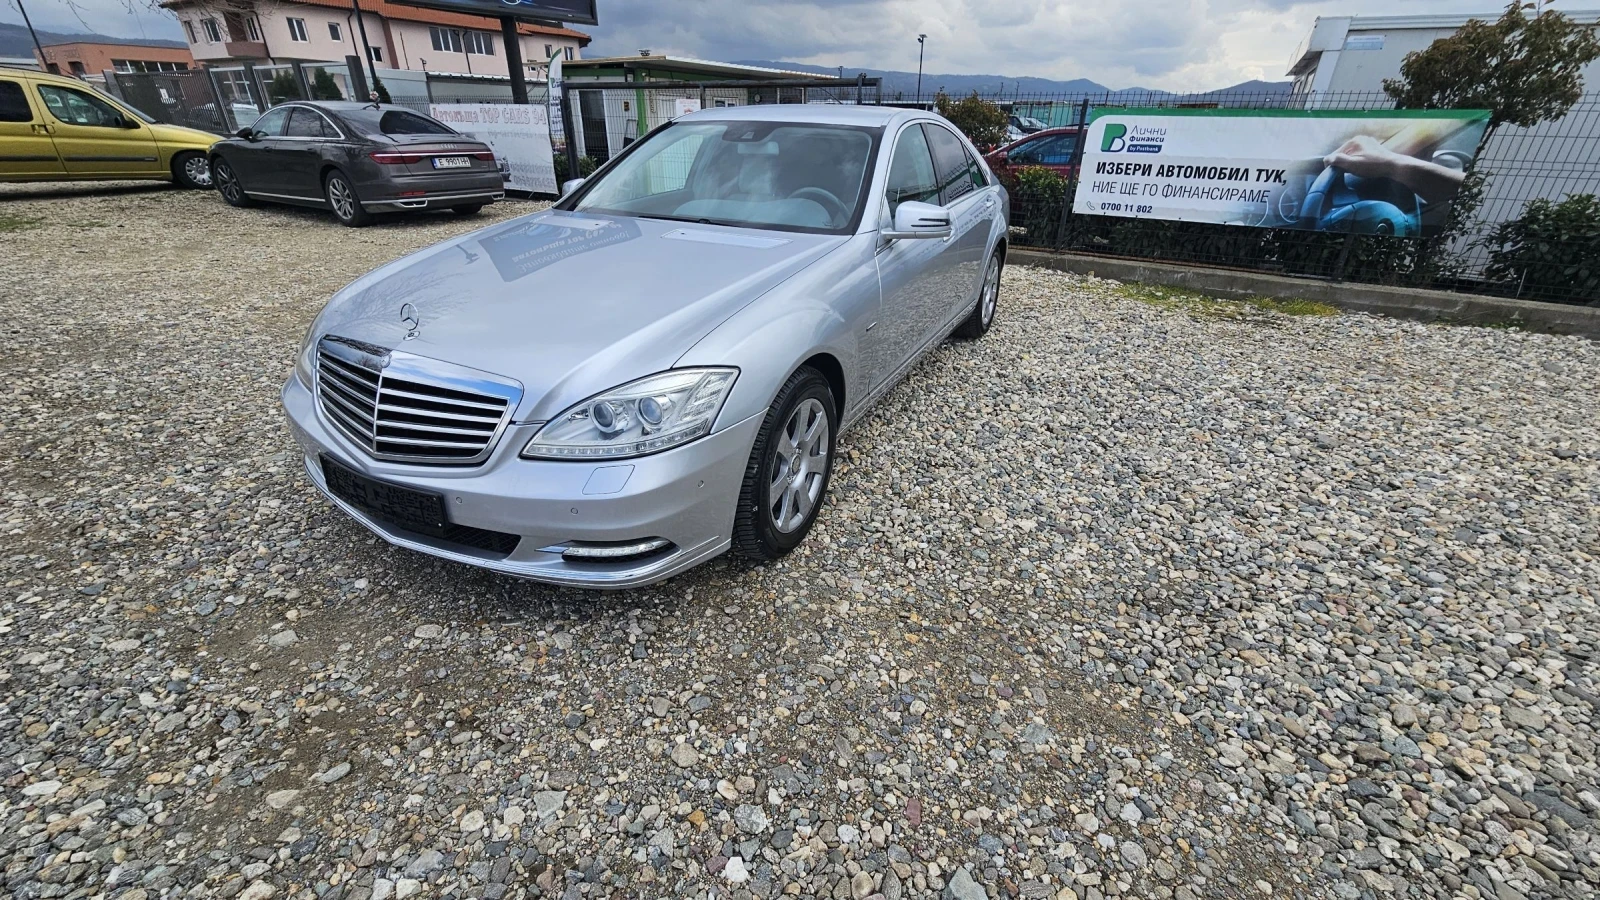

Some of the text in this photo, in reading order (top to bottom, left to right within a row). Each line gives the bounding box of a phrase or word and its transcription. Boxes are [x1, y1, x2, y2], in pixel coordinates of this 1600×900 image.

[480, 107, 500, 123] TOP
[502, 107, 529, 125] CARS
[532, 108, 547, 125] 94
[1130, 125, 1166, 136] Лични
[1129, 135, 1164, 143] Финанси
[1096, 161, 1288, 186] ИЗБЕРИ АВТОМОБИЛ ТУК,
[1091, 181, 1271, 204] НИЕ ЩЕ ГО ФИНАНСИРАМЕ
[1100, 202, 1153, 214] 0700 11 802
